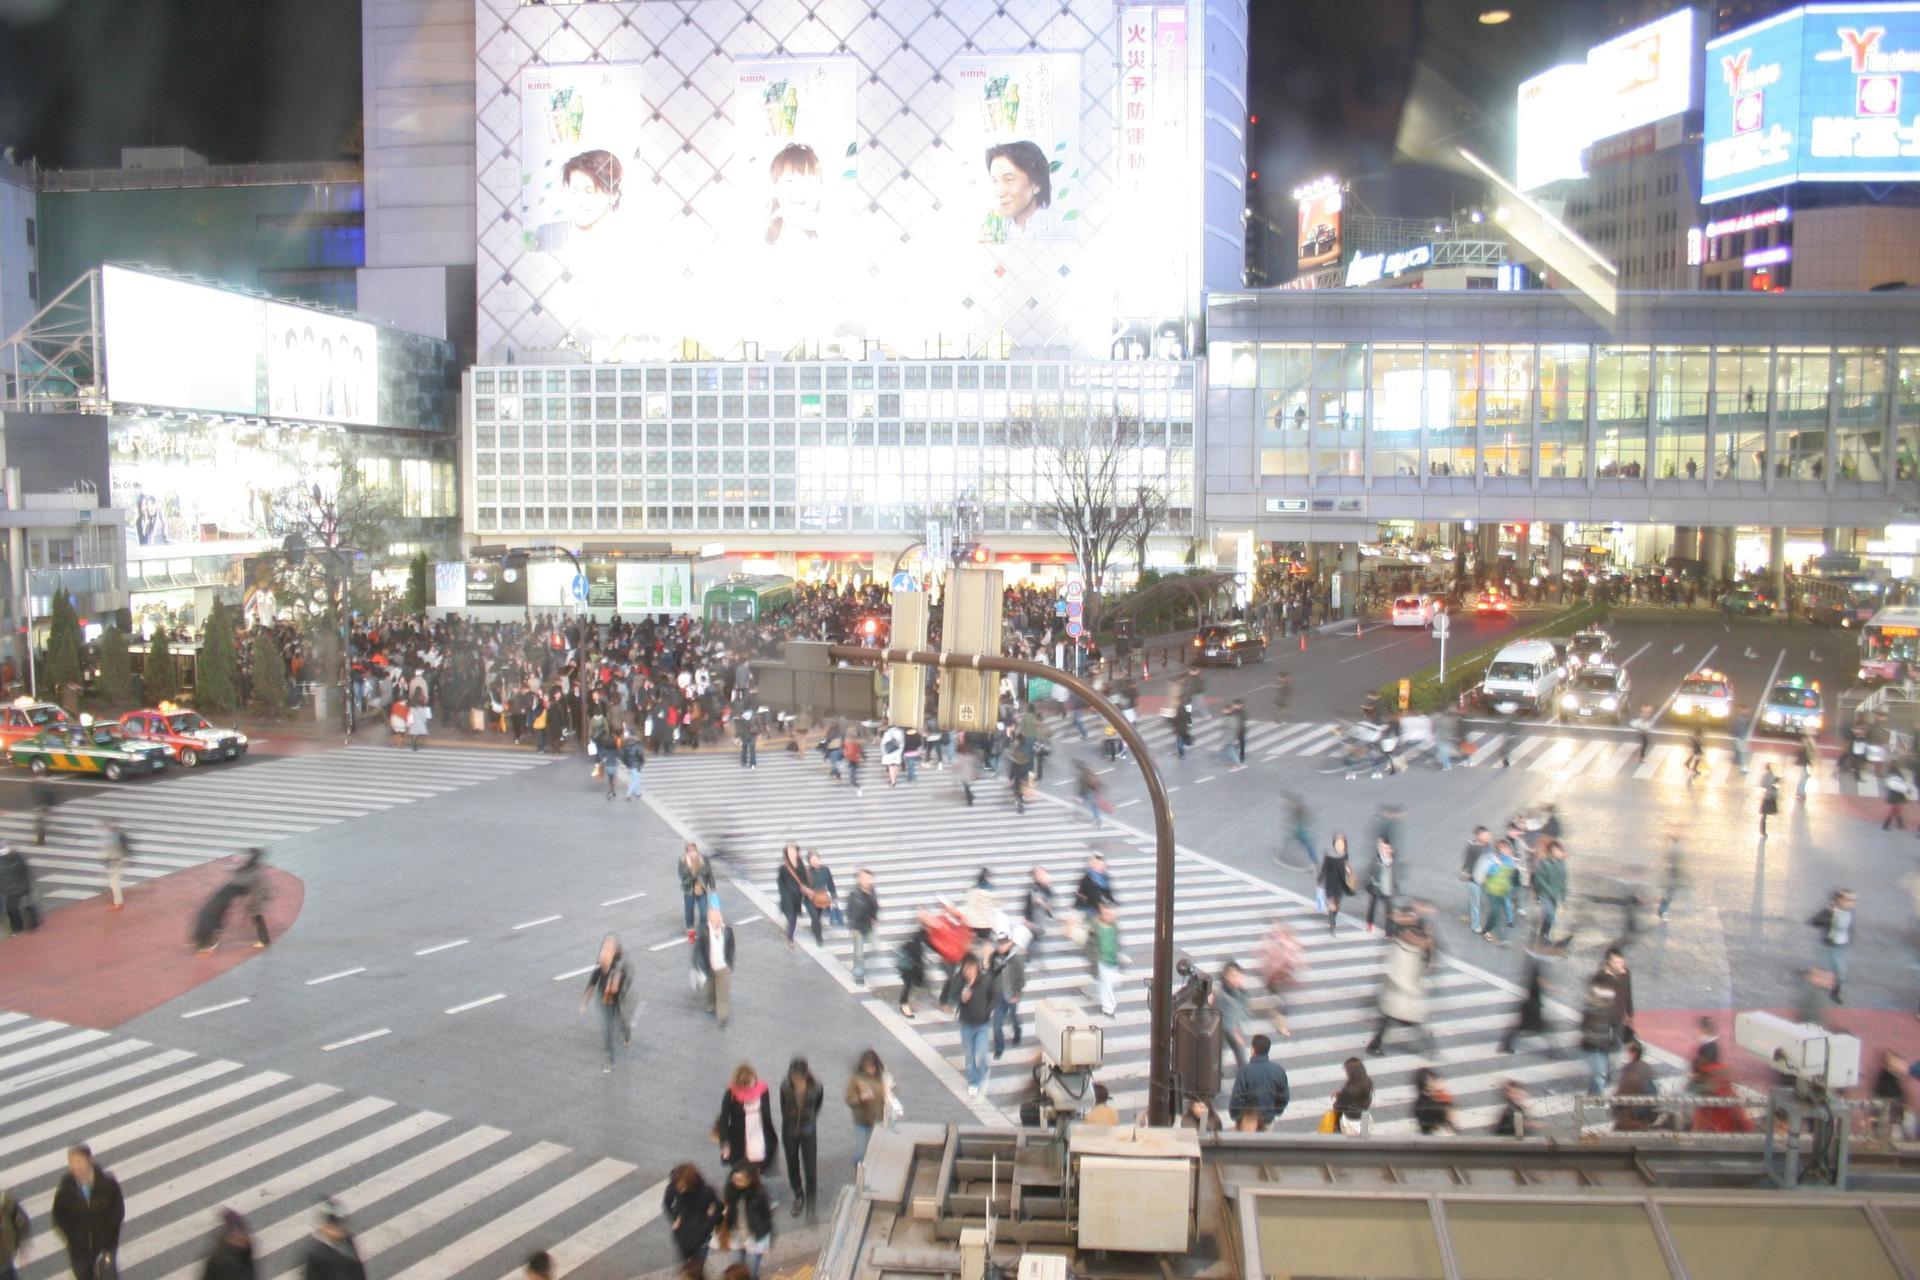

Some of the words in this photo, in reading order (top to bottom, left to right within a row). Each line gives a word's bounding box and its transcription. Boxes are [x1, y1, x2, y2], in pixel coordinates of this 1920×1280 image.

[960, 69, 986, 78] KIRIN
[739, 74, 766, 83] KIRIN
[527, 82, 552, 91] KIRIN
